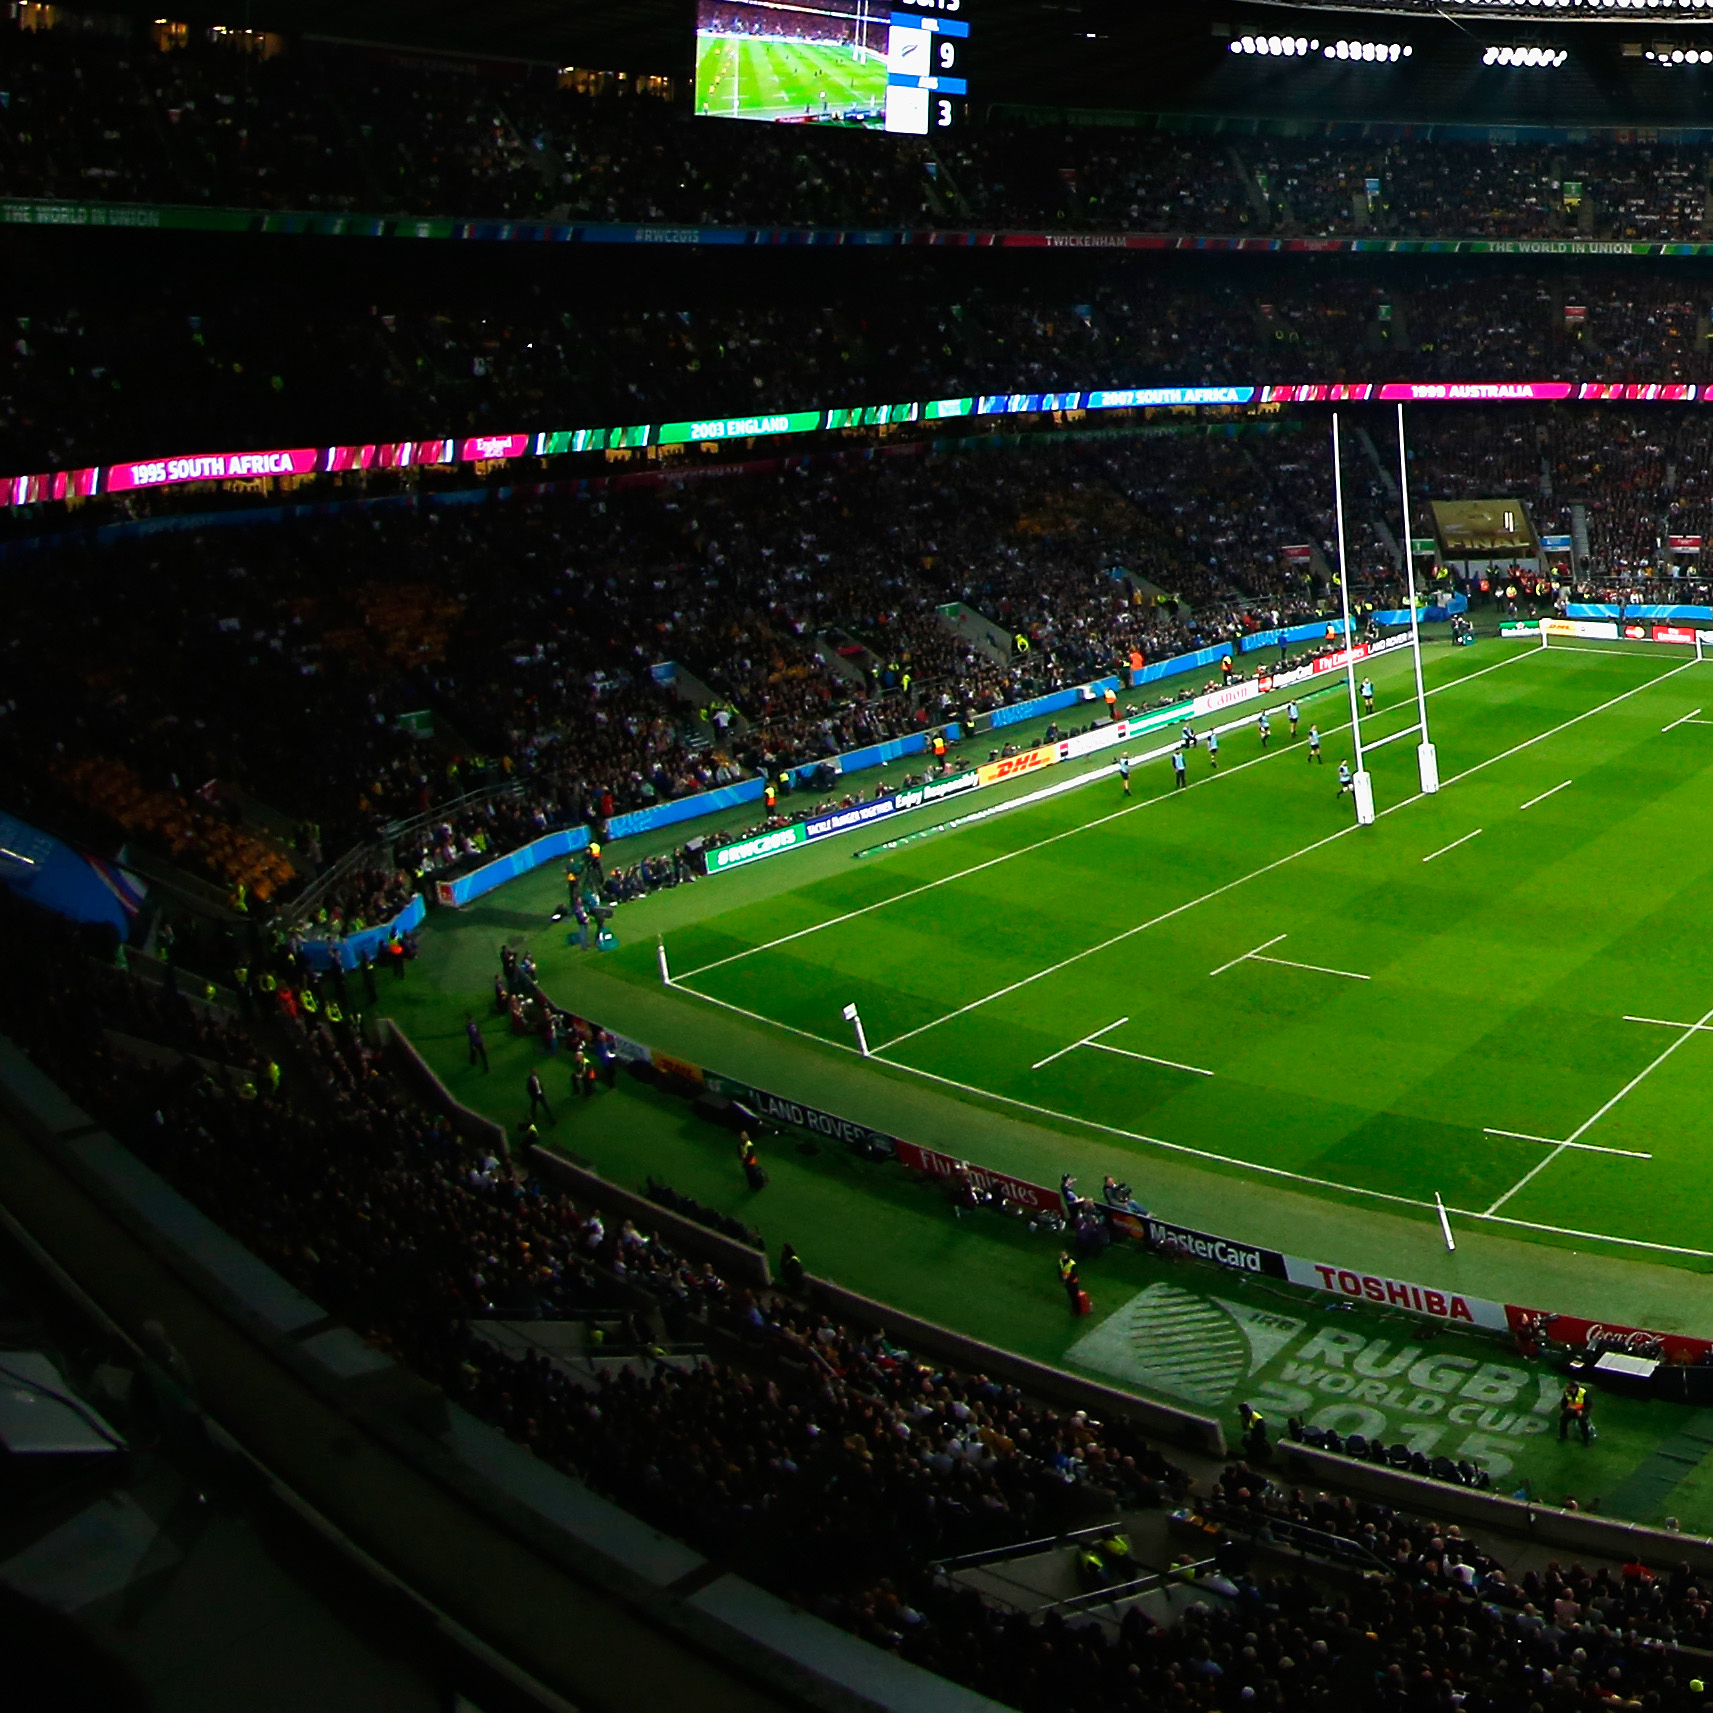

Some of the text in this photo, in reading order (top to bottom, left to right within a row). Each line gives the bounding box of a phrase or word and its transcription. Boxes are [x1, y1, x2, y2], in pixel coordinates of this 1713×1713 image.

[940, 42, 955, 69] 9
[937, 100, 952, 126] 3
[1045, 236, 1126, 247] TWICKENHAM
[1488, 242, 1633, 254] THE WORLD IN UNION
[1101, 388, 1239, 405] 2007 SOUTH AFRICA
[1411, 385, 1534, 398] 1999 AUSTRALIA
[690, 417, 789, 439] 2003 ENGLAND
[131, 453, 294, 486] 1995 SOUTH AFRICA
[1207, 688, 1248, 708] Canon
[997, 752, 1042, 778] DHL
[895, 772, 979, 809] Enjoy Responsibly
[717, 829, 796, 865] #RWC2015
[756, 1091, 804, 1126] LAND
[920, 1149, 1039, 1206] Fly mirates
[1149, 1222, 1261, 1272] MasterCard
[1315, 1265, 1474, 1323] TOSHIBA
[1296, 1326, 1571, 1416] RUGBY
[1278, 1359, 1550, 1436] WORLD CUP
[1246, 1380, 1527, 1480] 2015
